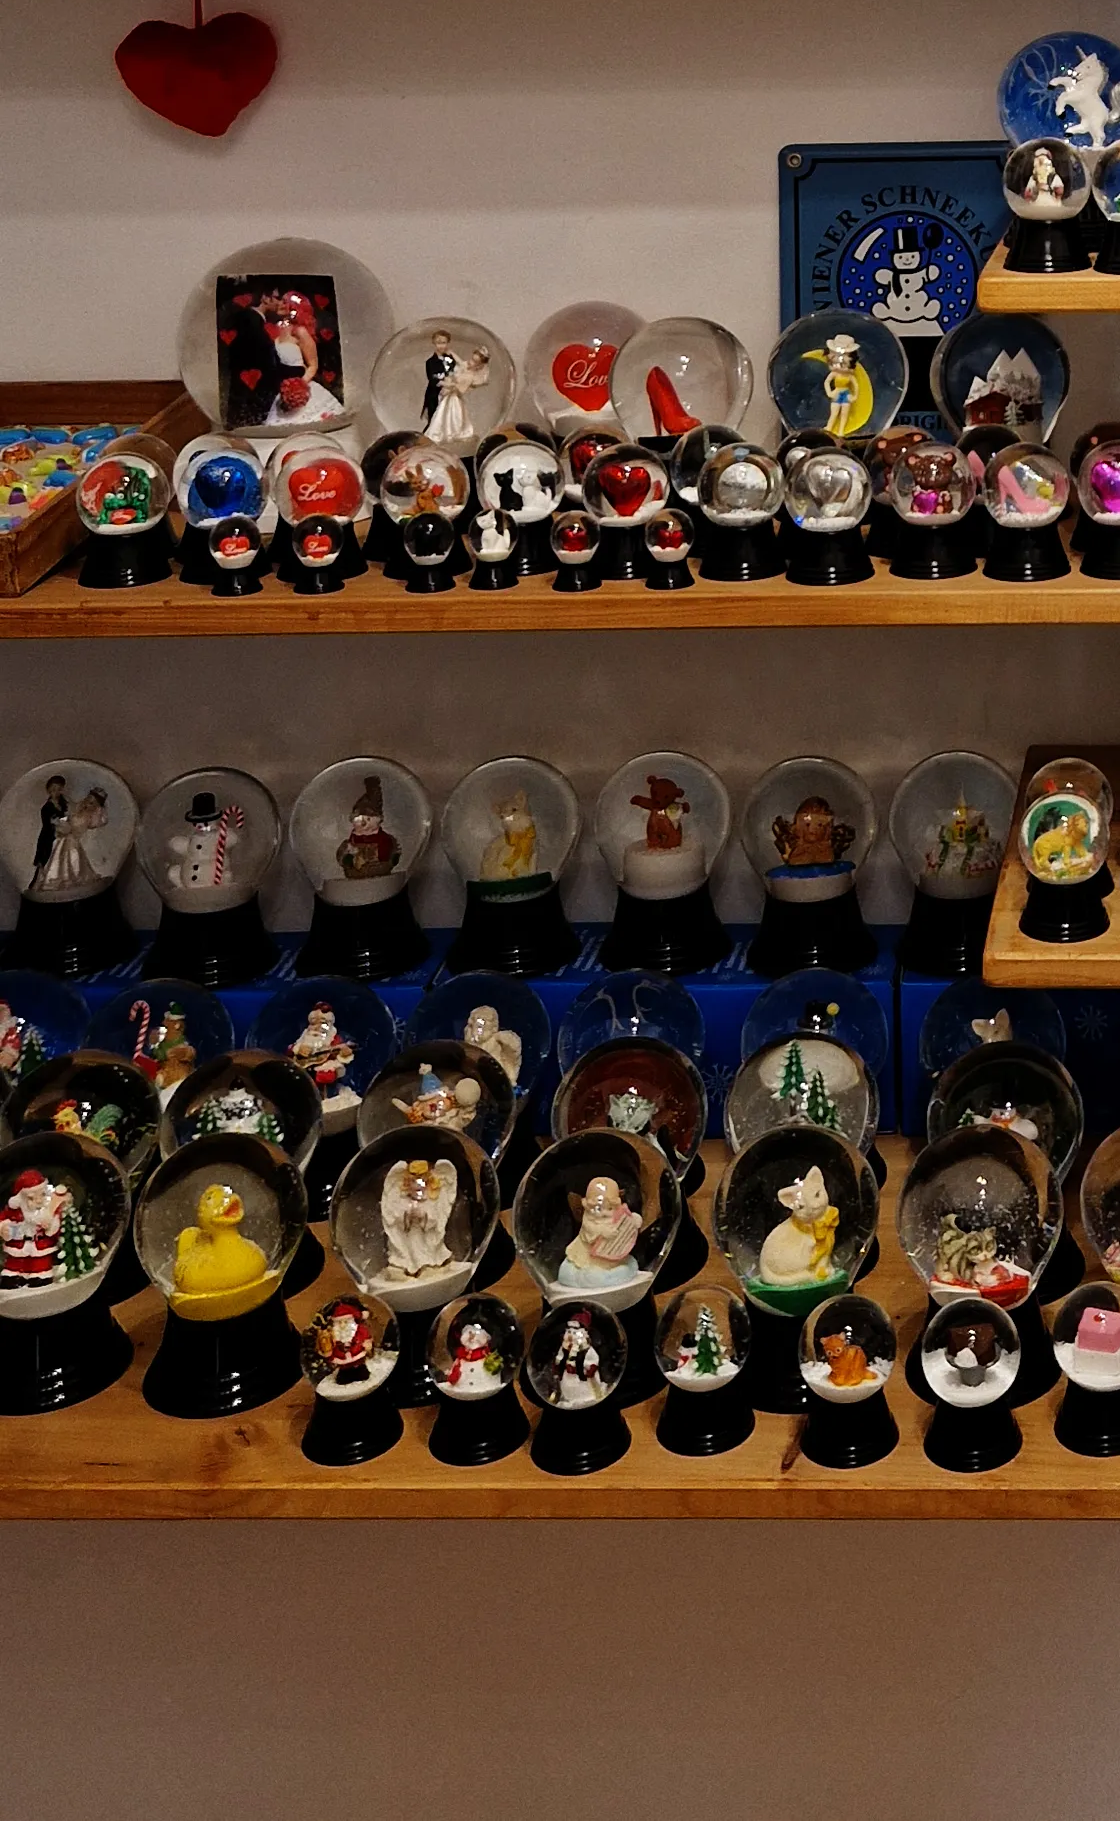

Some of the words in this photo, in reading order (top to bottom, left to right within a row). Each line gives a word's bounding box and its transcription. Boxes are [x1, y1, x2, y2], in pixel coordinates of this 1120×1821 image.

[860, 184, 997, 261] SCHNEEK
[563, 359, 609, 389] Lov
[297, 482, 337, 502] Love
